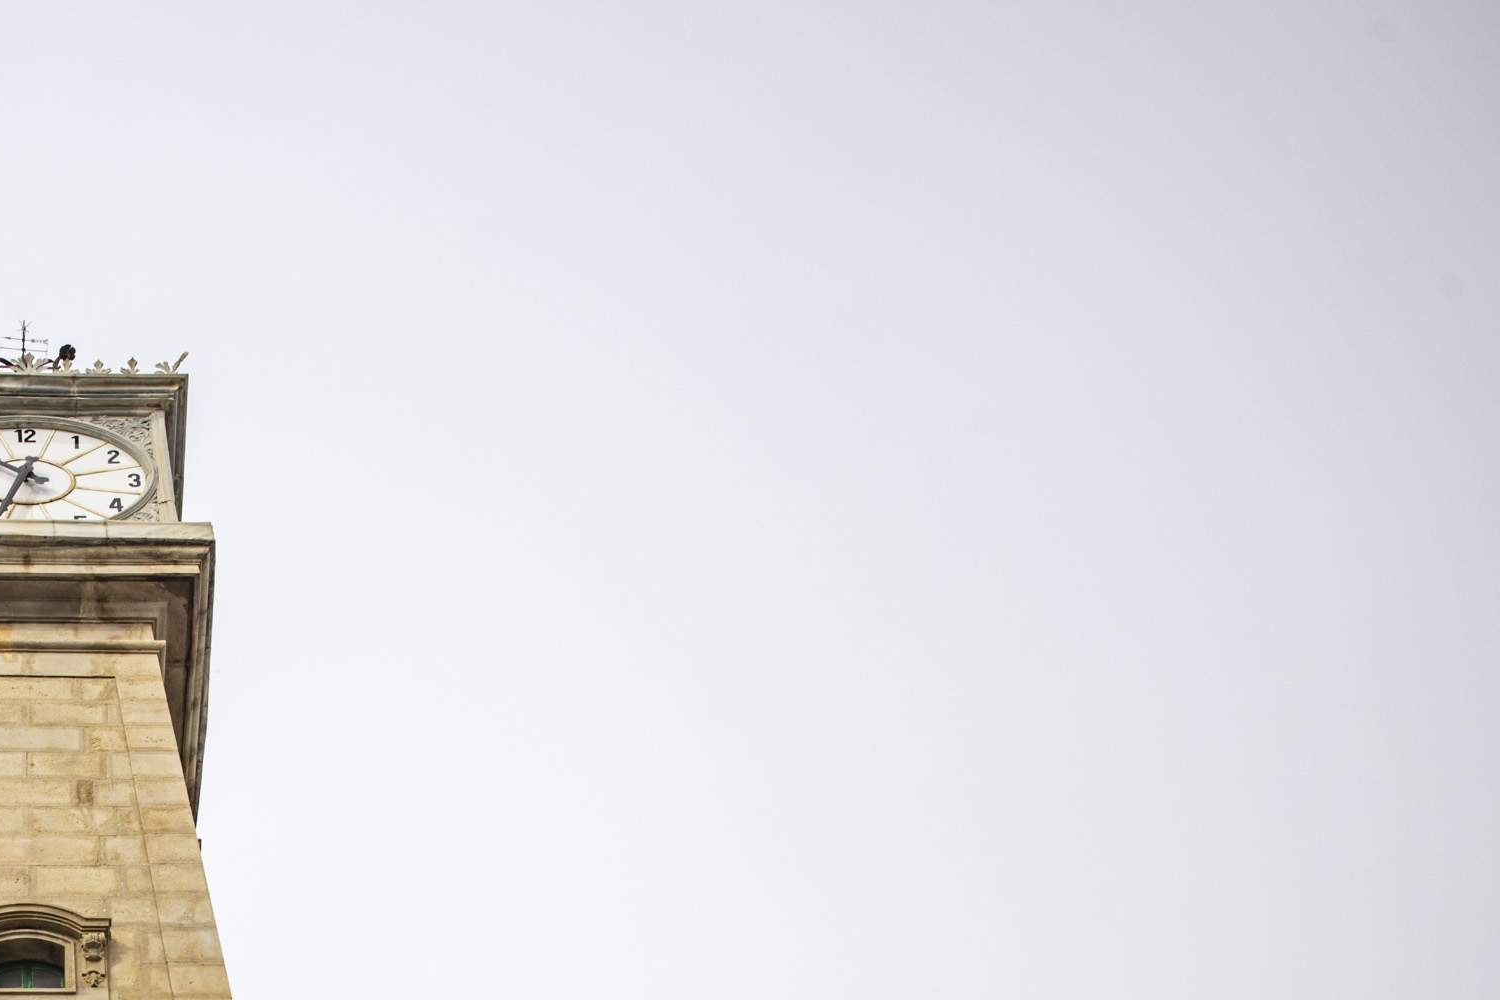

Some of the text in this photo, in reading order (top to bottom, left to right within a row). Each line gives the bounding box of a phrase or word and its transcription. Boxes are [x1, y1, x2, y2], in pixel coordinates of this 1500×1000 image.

[14, 429, 37, 443] 12
[71, 435, 80, 449] 1
[107, 450, 120, 464] 2
[127, 473, 141, 488] 3
[109, 498, 124, 512] 4
